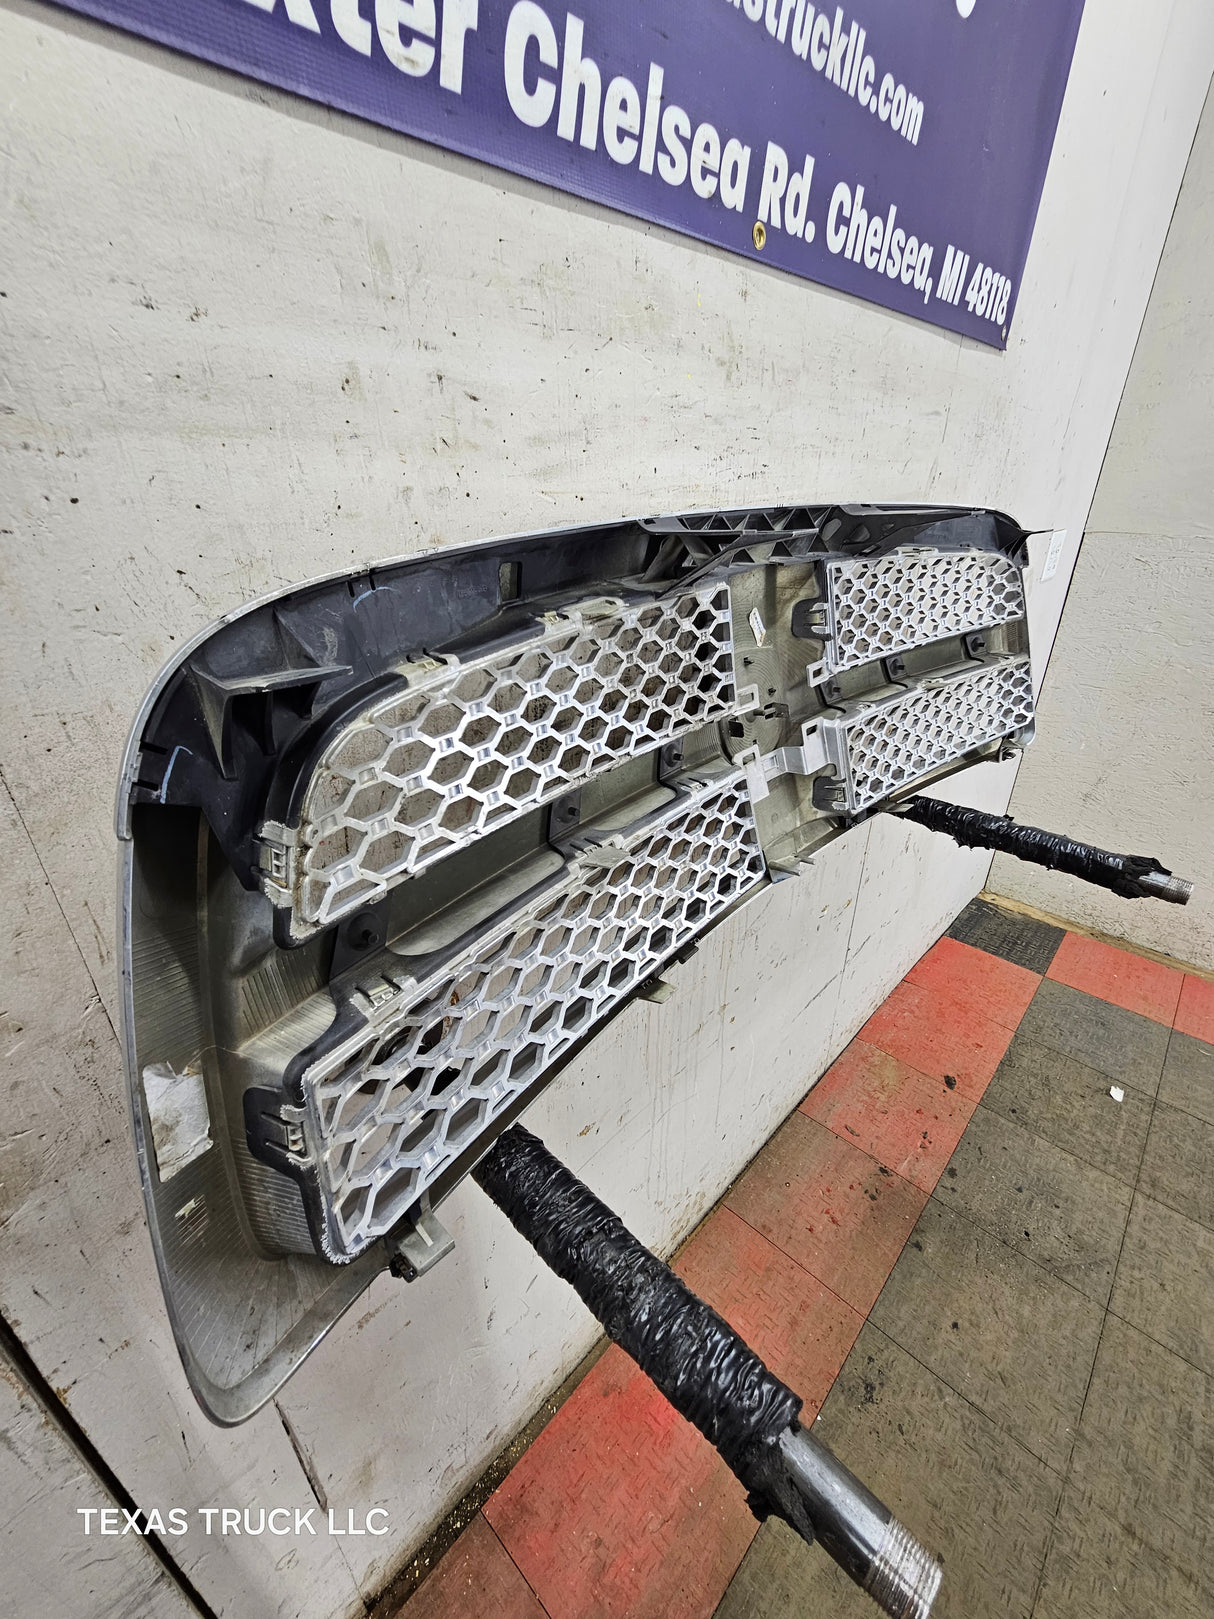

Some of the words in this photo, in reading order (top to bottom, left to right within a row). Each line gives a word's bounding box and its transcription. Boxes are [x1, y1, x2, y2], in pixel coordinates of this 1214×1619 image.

[504, 0, 752, 213] Chelsea
[757, 141, 815, 243] Rd.
[826, 181, 933, 304] Chelsea,
[936, 244, 970, 305] MI
[966, 262, 1011, 325] 48118
[725, 0, 924, 145] ruckllc.com
